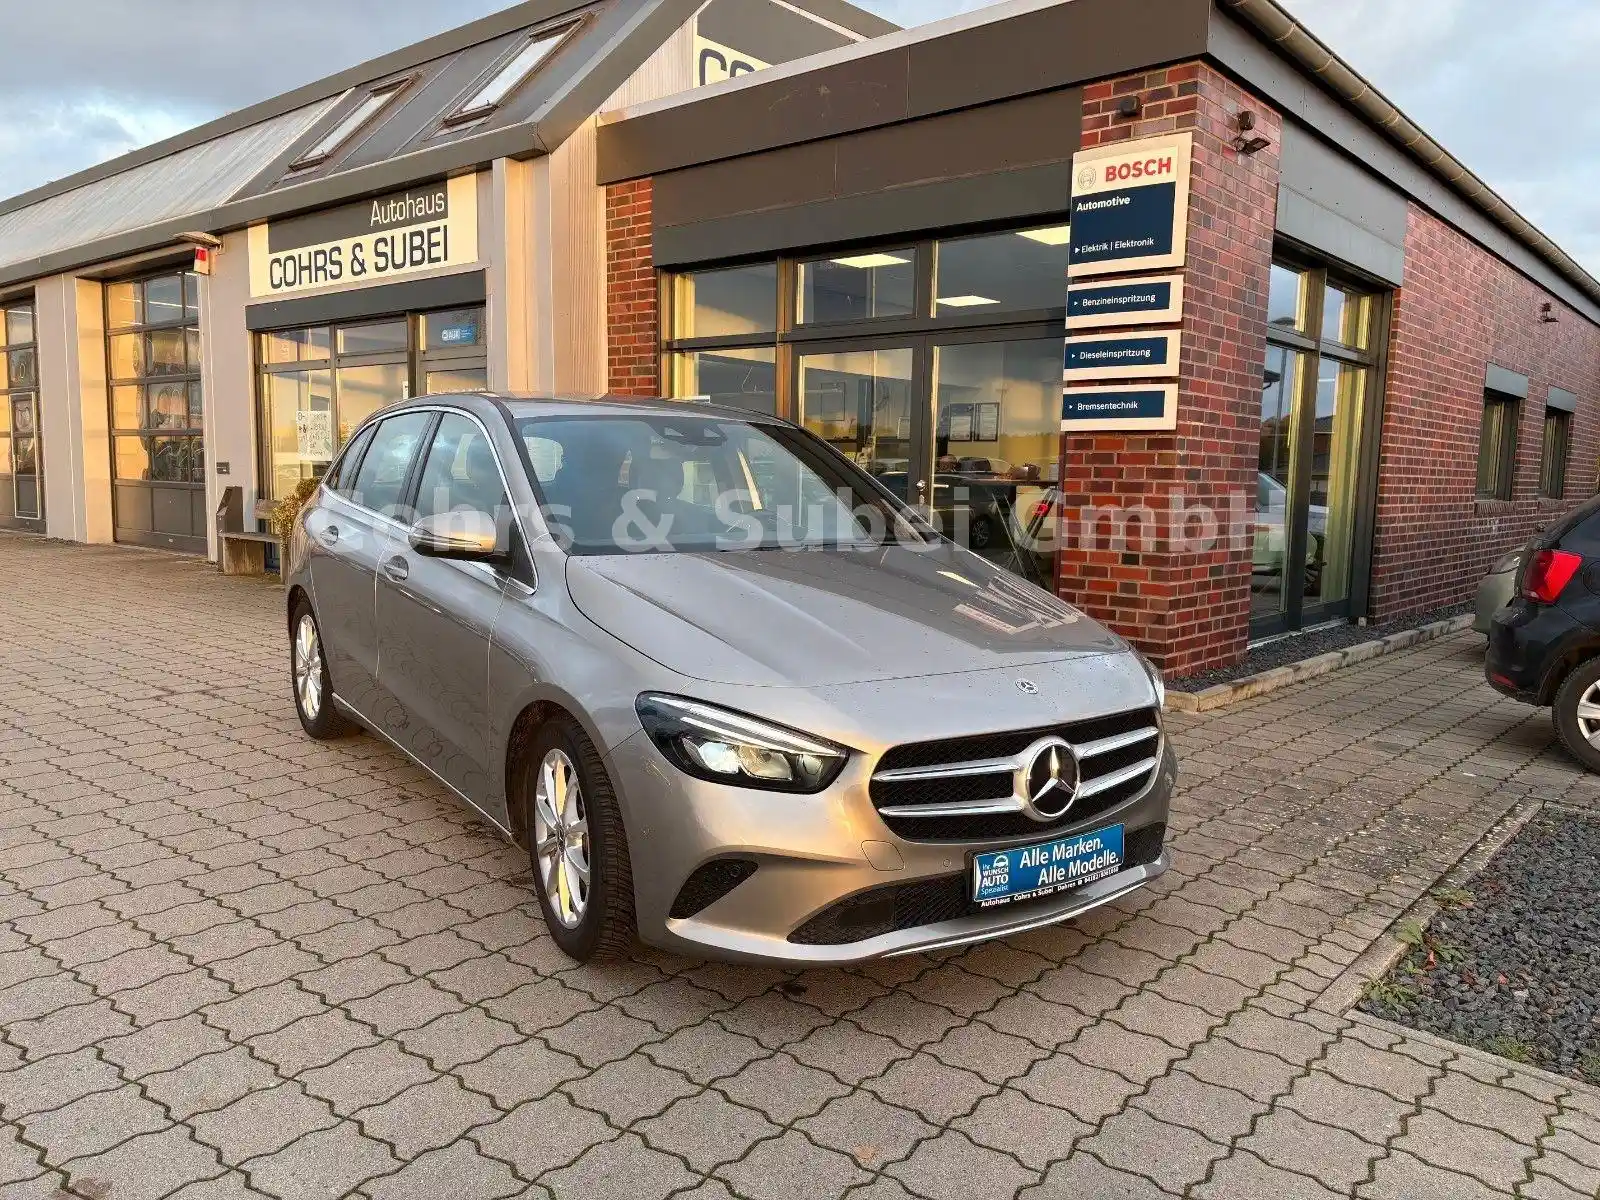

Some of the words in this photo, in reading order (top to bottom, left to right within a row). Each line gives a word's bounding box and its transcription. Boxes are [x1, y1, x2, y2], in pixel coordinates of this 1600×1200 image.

[1105, 157, 1172, 182] BOSCH
[370, 192, 444, 227] Autohaus
[1076, 196, 1131, 212] Automotive
[1081, 242, 1109, 253] Elektrik
[1114, 237, 1155, 249] Elektronik
[270, 246, 342, 289] COHRS
[350, 242, 367, 276] &
[374, 224, 448, 272] SUBEI
[1082, 294, 1156, 307] Benzineinspritzung
[1080, 349, 1151, 360] Dieseleinspritzung
[1077, 401, 1138, 411] Bremsentechnik
[1019, 851, 1049, 869] Alle
[1052, 836, 1104, 862] Marken.
[982, 867, 1009, 876] WUNSCH
[1038, 864, 1066, 886] Alle
[1068, 849, 1119, 878] Modelle.
[981, 874, 1009, 888] AUTO
[980, 897, 1011, 908] Autohaus
